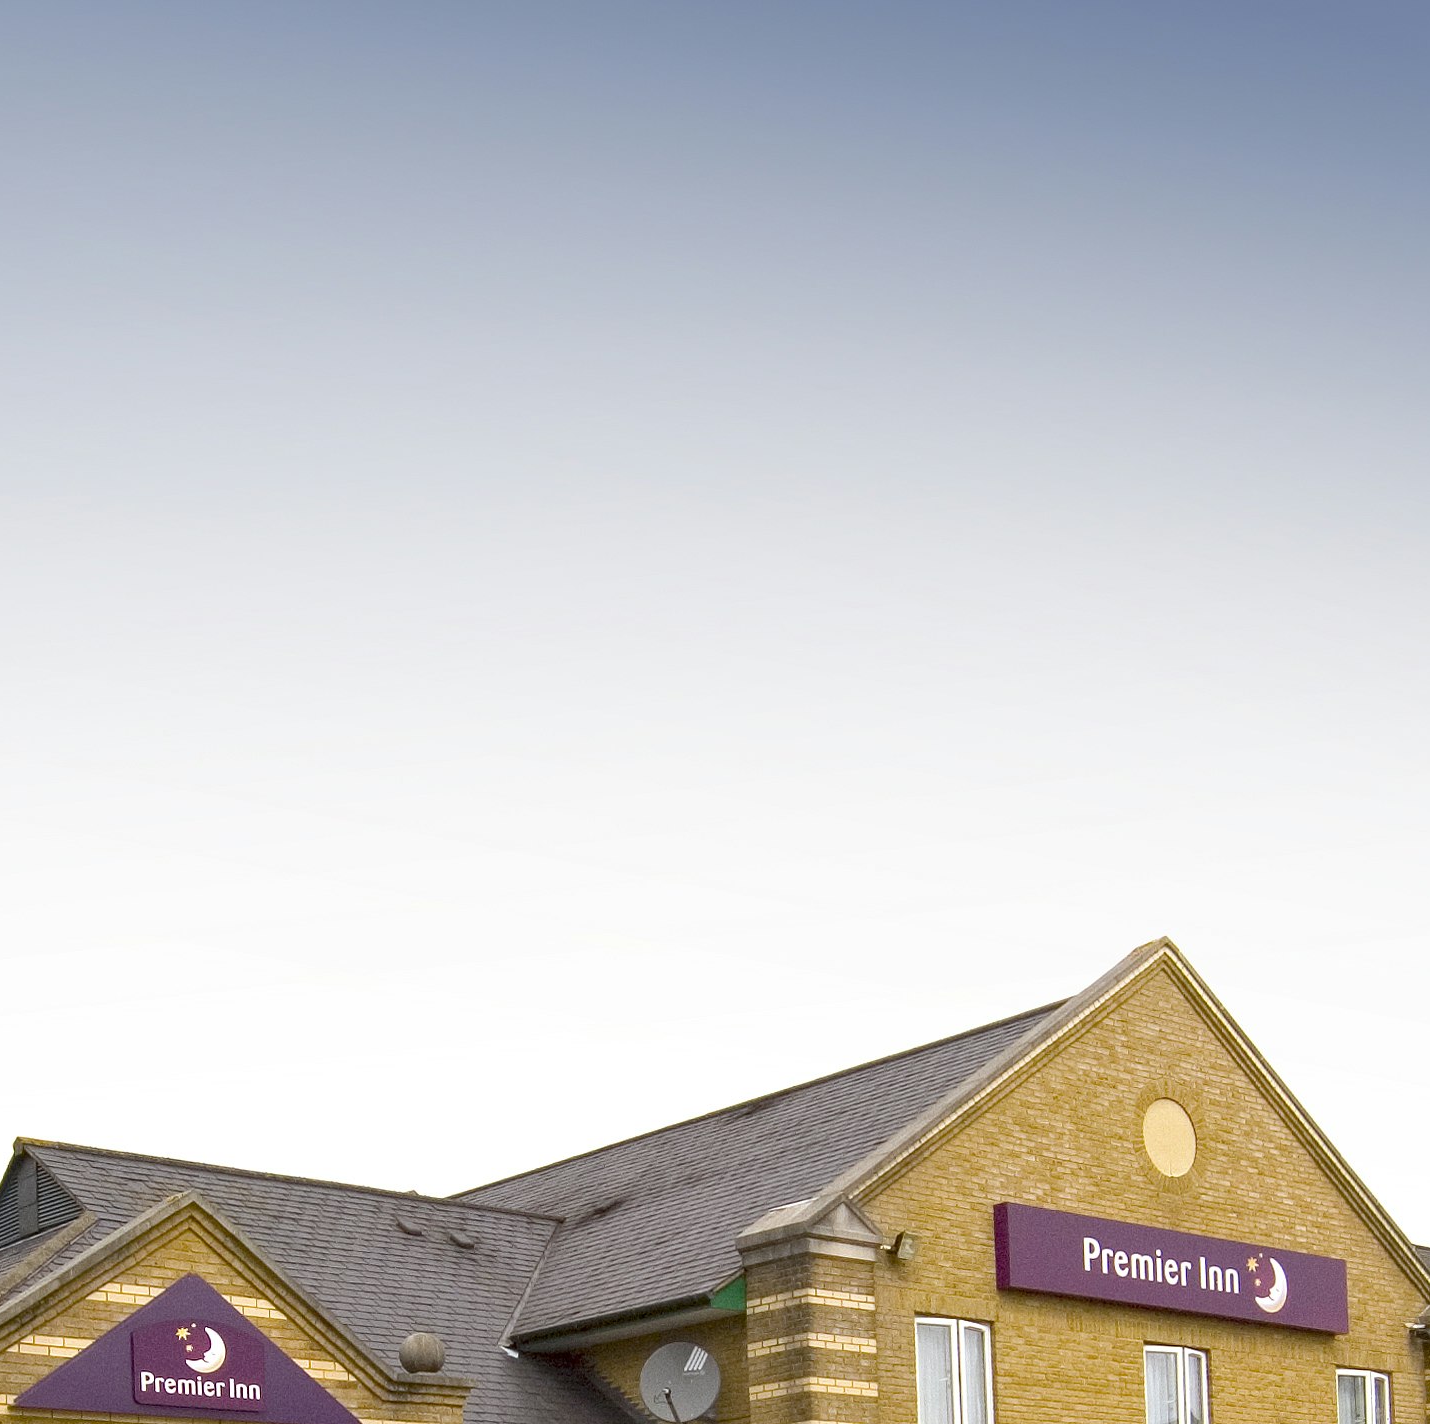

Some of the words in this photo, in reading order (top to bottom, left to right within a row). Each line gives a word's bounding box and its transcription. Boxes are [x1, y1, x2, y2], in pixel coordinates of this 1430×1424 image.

[1083, 1237, 1192, 1287] Premier
[1199, 1256, 1240, 1294] Inn
[140, 1371, 226, 1398] Premier
[229, 1378, 261, 1400] Inn
